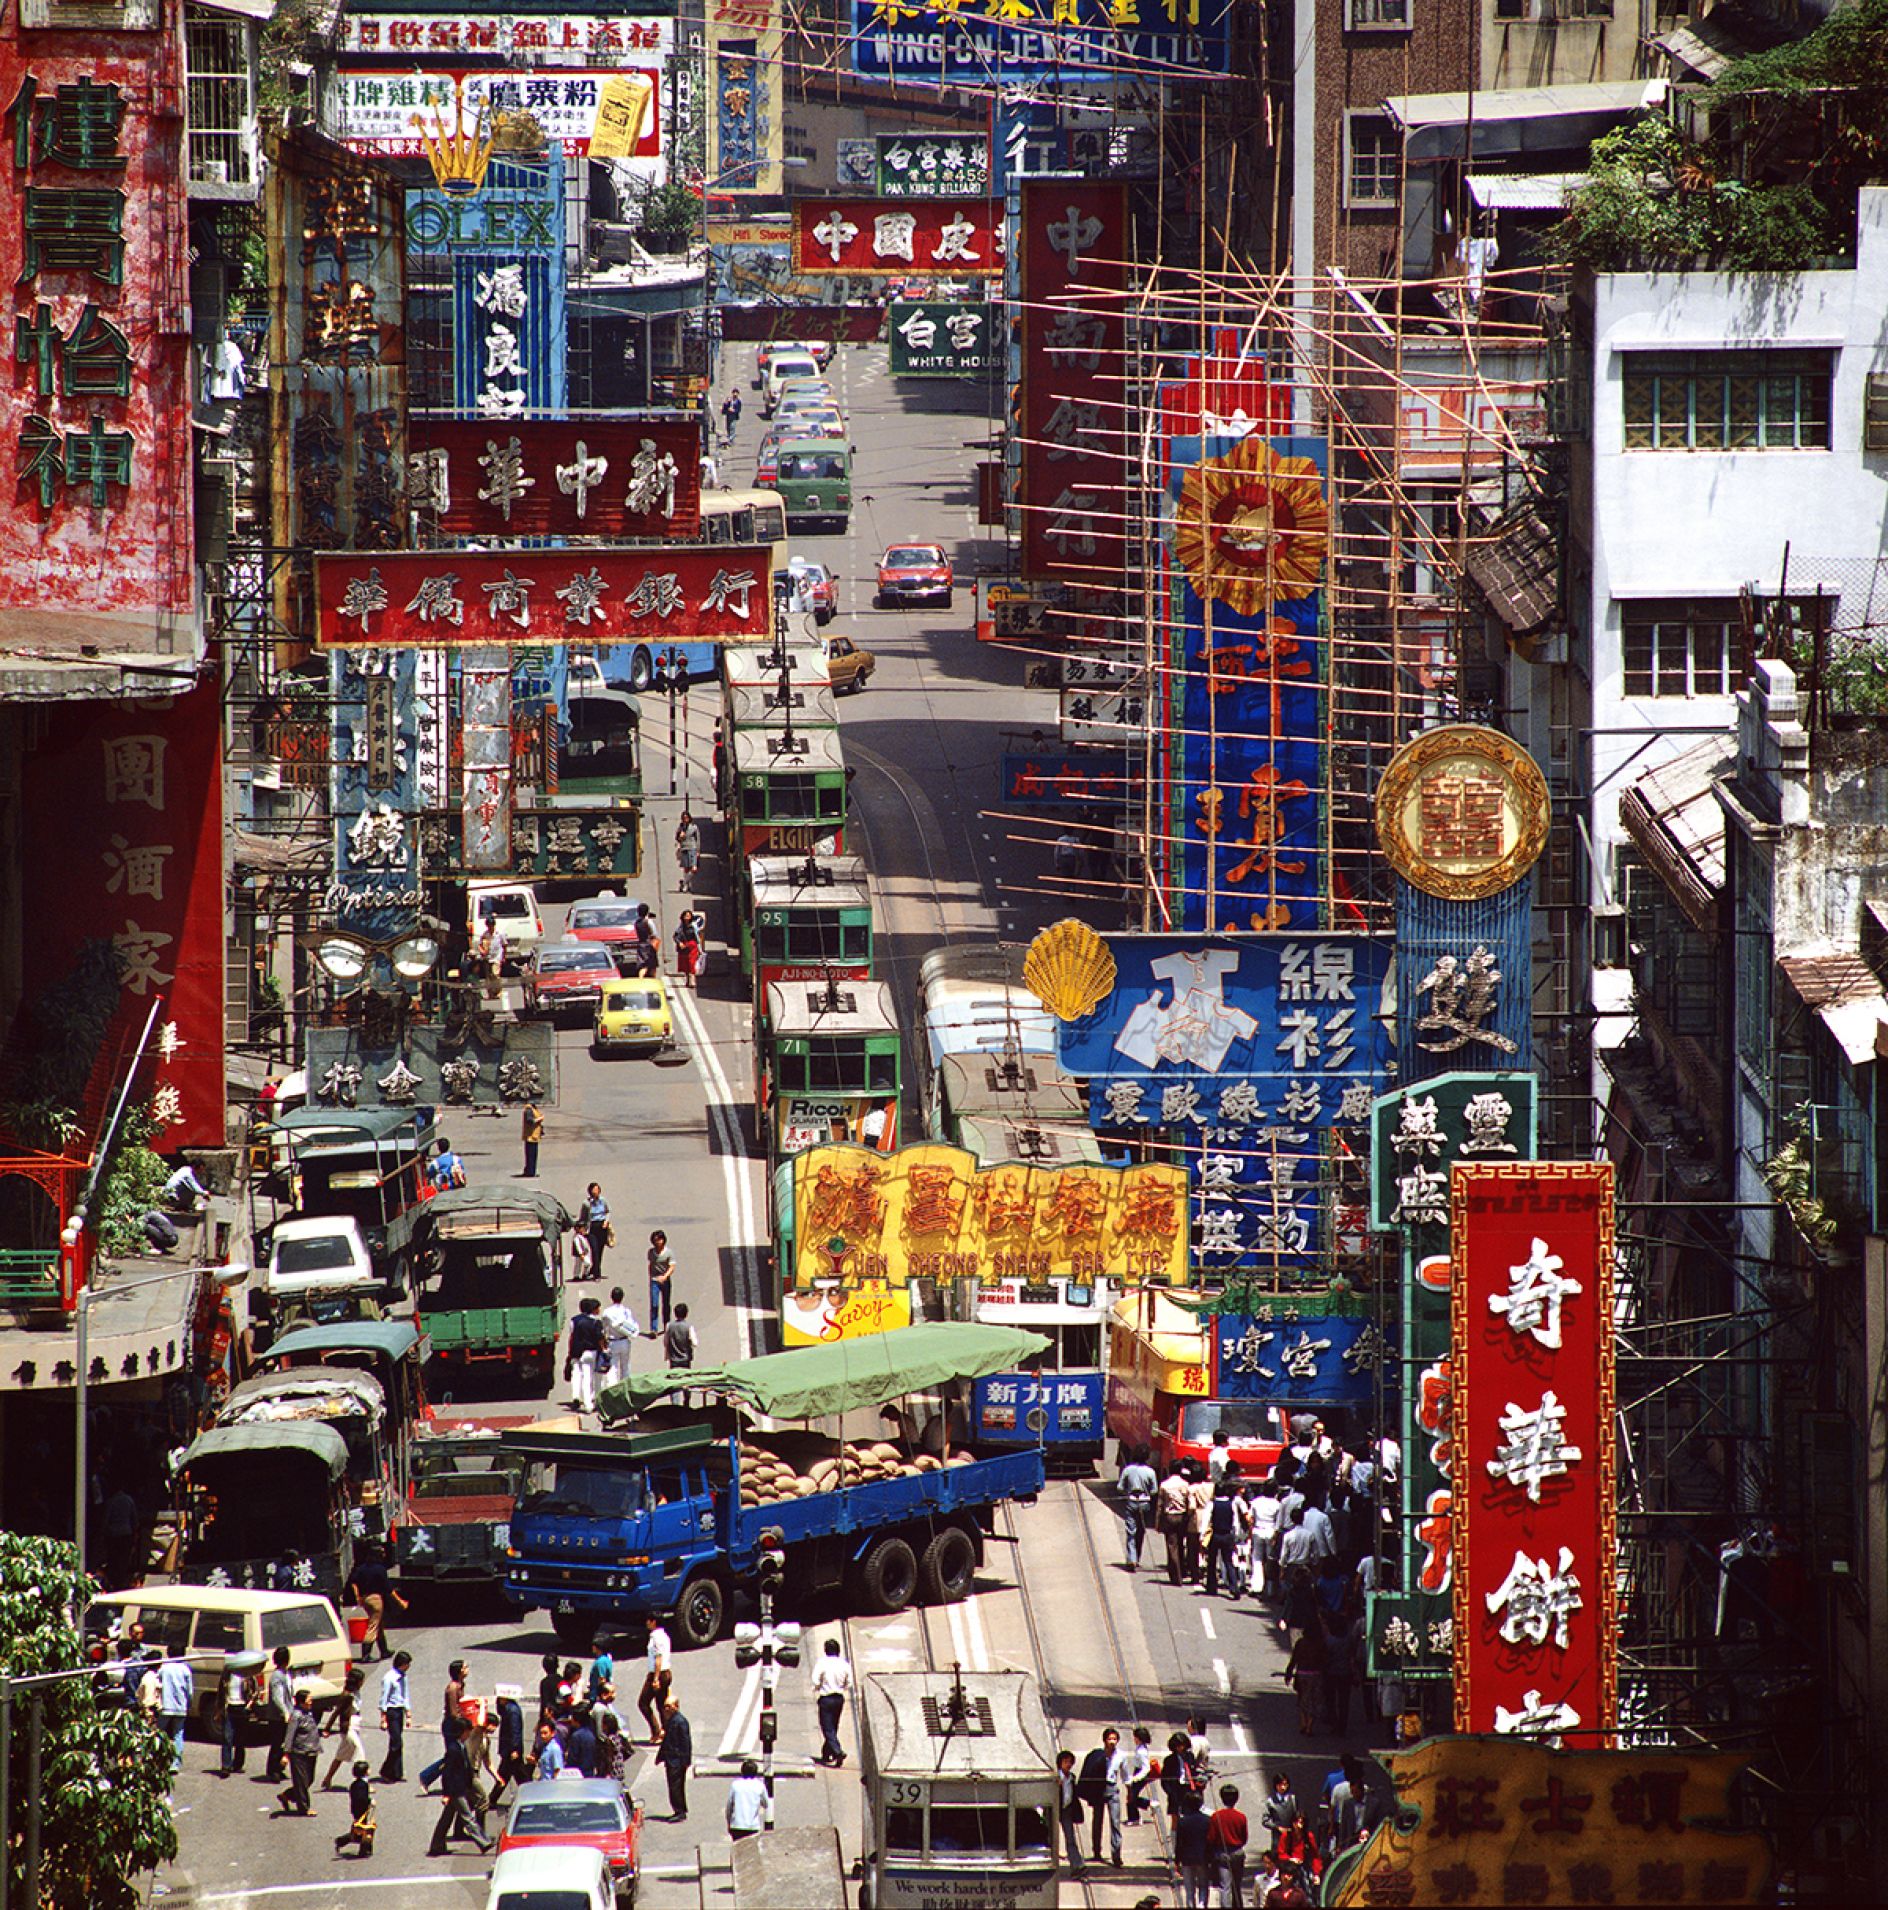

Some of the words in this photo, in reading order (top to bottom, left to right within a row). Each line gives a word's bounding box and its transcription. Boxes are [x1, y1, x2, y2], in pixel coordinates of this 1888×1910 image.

[875, 33, 943, 63] WING
[955, 33, 993, 63] ON
[1003, 33, 1139, 63] JEWELRY
[405, 200, 556, 247] OLEX
[908, 356, 954, 368] WHITE
[336, 565, 759, 634] 華僑商業銀行
[746, 775, 764, 789] 58
[101, 696, 175, 996] 團酒家
[325, 882, 433, 916] Optician
[762, 911, 783, 926] 95
[1276, 942, 1357, 1069] 線衫
[783, 1039, 801, 1054] 71
[790, 1099, 852, 1116] RICOH
[907, 1253, 978, 1276] CHEONG
[994, 1252, 1051, 1275] SNACK
[1072, 1252, 1105, 1275] BAR
[820, 1299, 893, 1342] Savoy
[986, 1381, 1088, 1405] 新力牌
[537, 1532, 600, 1548] ISUZU
[891, 1782, 921, 1804] 39
[895, 1880, 914, 1895] We
[916, 1880, 949, 1895] work
[953, 1880, 996, 1895] harder
[1000, 1880, 1017, 1895] for
[1018, 1883, 1044, 1898] you
